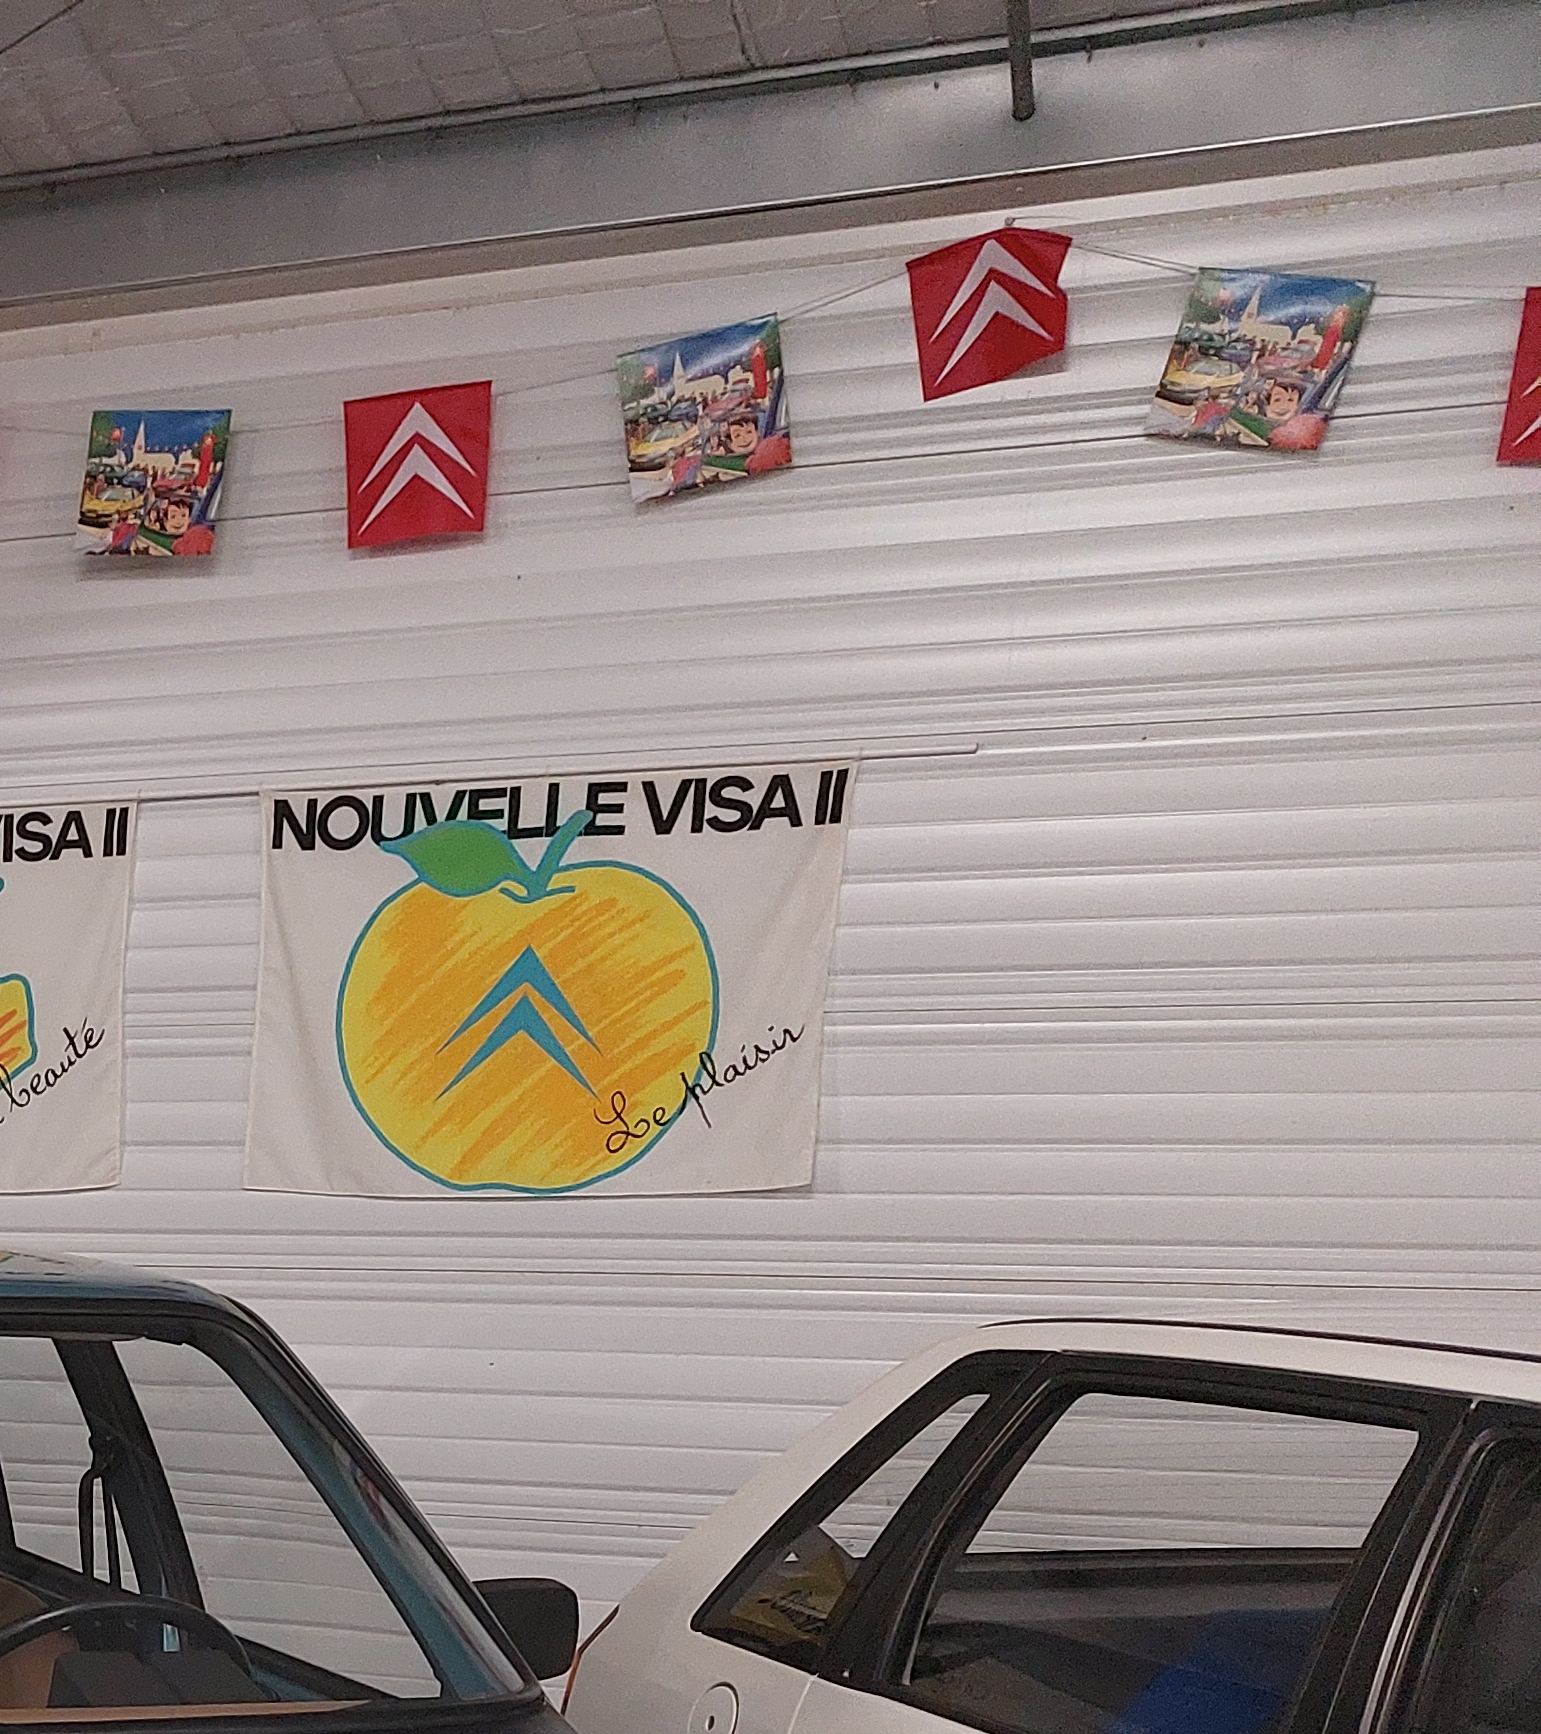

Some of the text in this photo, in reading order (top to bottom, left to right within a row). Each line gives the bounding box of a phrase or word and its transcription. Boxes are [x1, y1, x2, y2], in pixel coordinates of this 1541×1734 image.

[102, 807, 129, 857] II
[272, 768, 849, 851] NOUVELLE VISA II
[594, 1022, 806, 1155] Le plaisir
